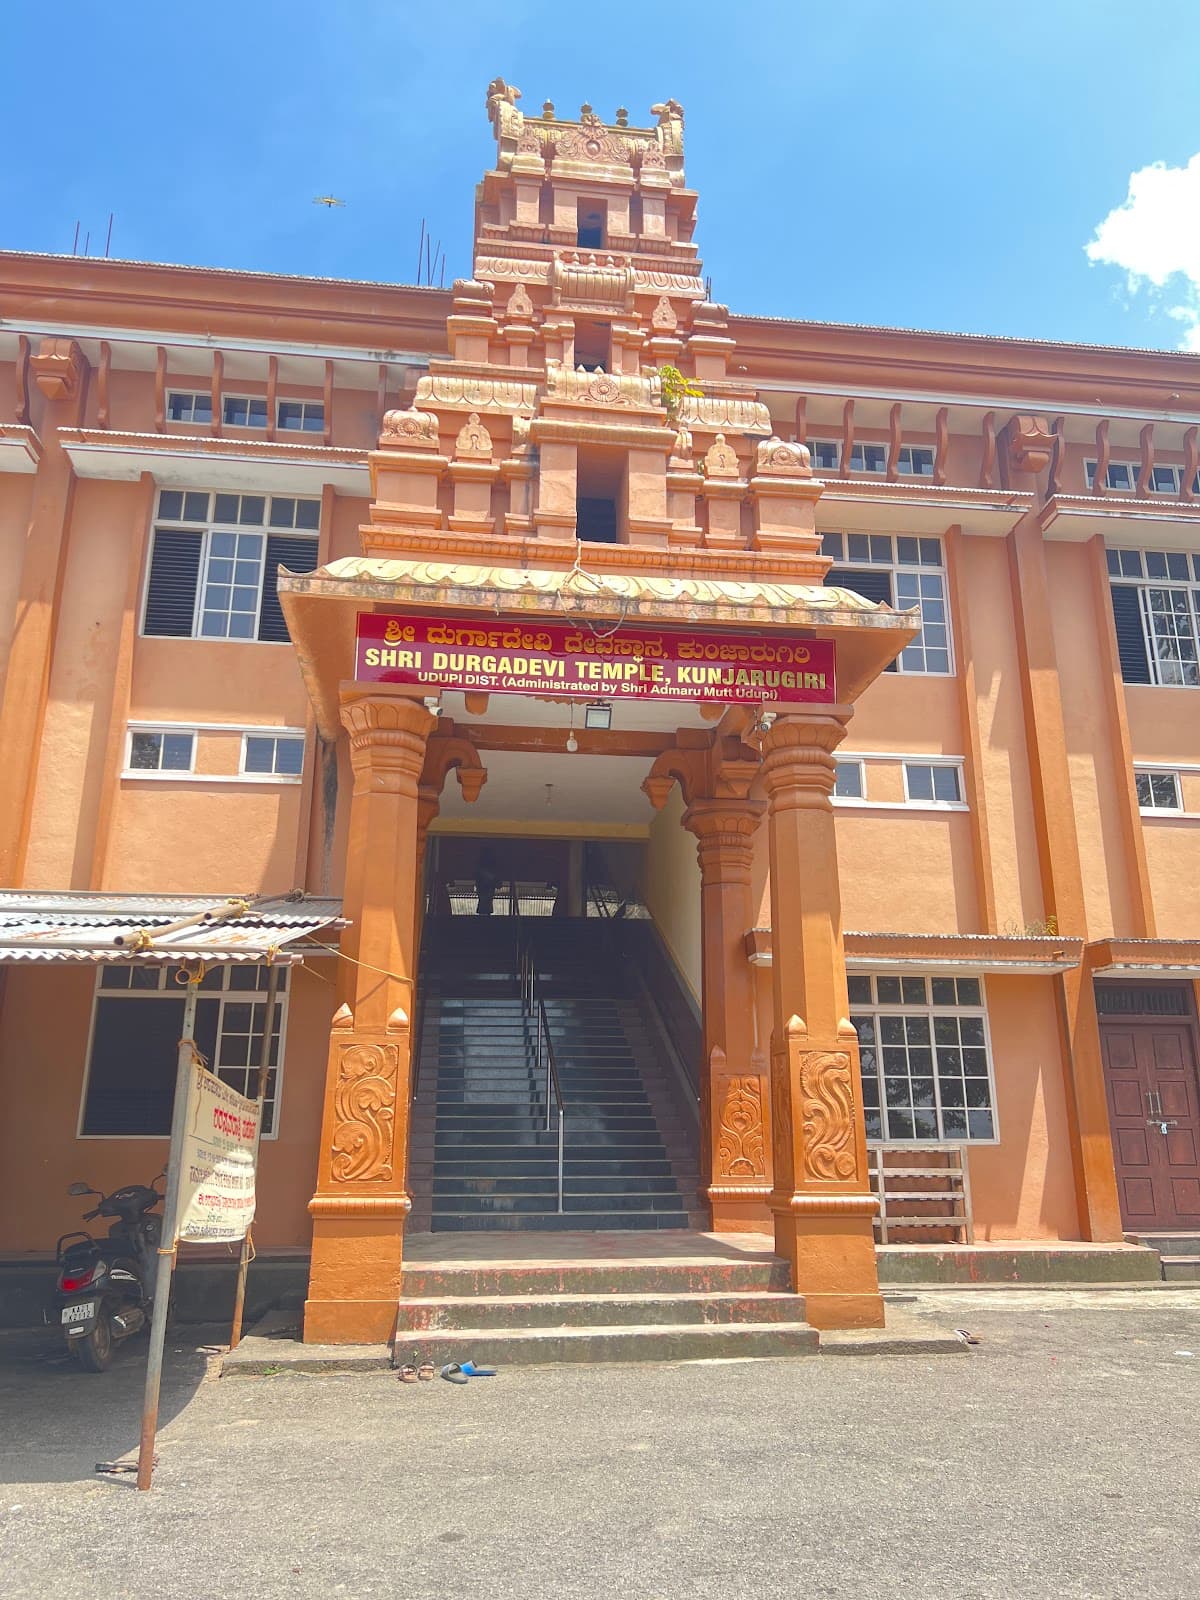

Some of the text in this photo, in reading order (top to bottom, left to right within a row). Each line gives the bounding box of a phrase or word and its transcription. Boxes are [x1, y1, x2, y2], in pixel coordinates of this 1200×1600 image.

[383, 619, 416, 647] ಶ್ರೀ
[426, 623, 553, 651] ದುರ್ಗಾದೇವಿ
[677, 639, 811, 664] ಕುಂಜಾರುಗಿರಿ
[365, 648, 827, 690] SHRI DURGADEVI TEMPLE, KUNJARUGIRI
[417, 671, 778, 701] UDUPI DIST. (Administrated by Shri Admaru Mutt Udupi)
